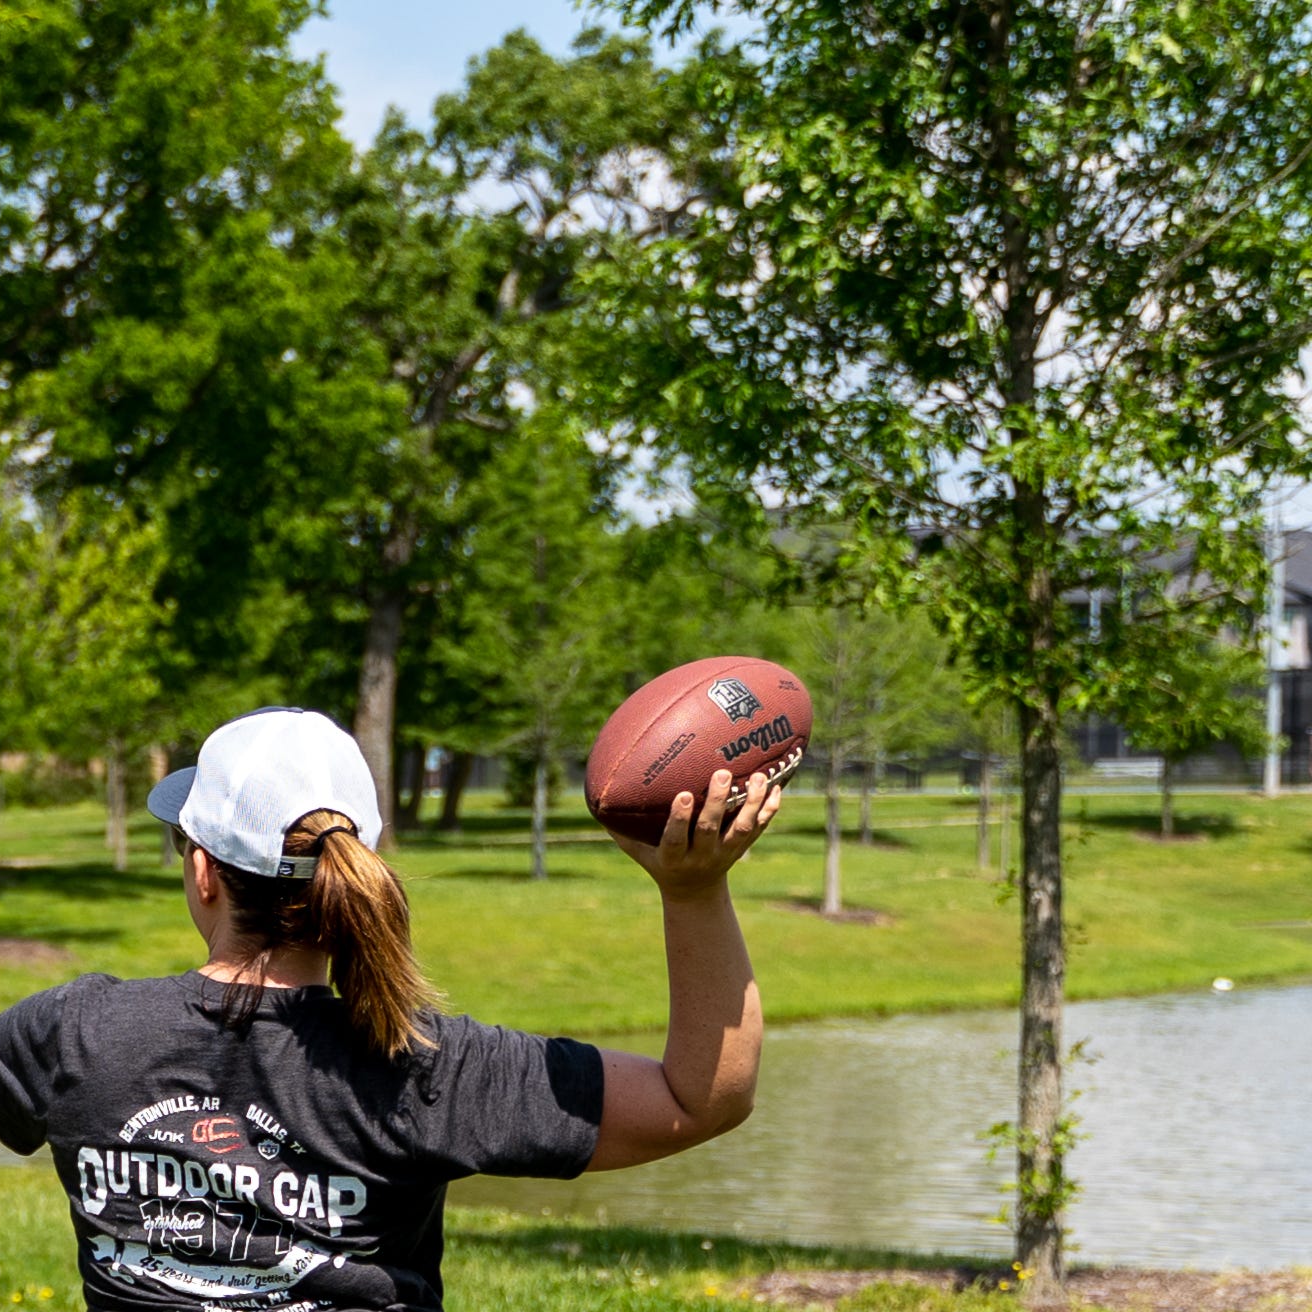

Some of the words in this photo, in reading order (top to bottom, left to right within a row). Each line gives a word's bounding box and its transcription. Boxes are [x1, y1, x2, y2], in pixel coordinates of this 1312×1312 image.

[720, 714, 795, 762] Wilson
[119, 1095, 200, 1143] BENTONVILLE,
[202, 1096, 220, 1110] AR
[290, 1141, 308, 1154] TX
[77, 1146, 260, 1215] OUTDOOR
[272, 1171, 367, 1237] CAP
[143, 1214, 206, 1230] established
[139, 1256, 164, 1272] 45
[159, 1266, 195, 1284] years
[201, 1276, 225, 1288] and
[267, 1290, 292, 1306] MX
